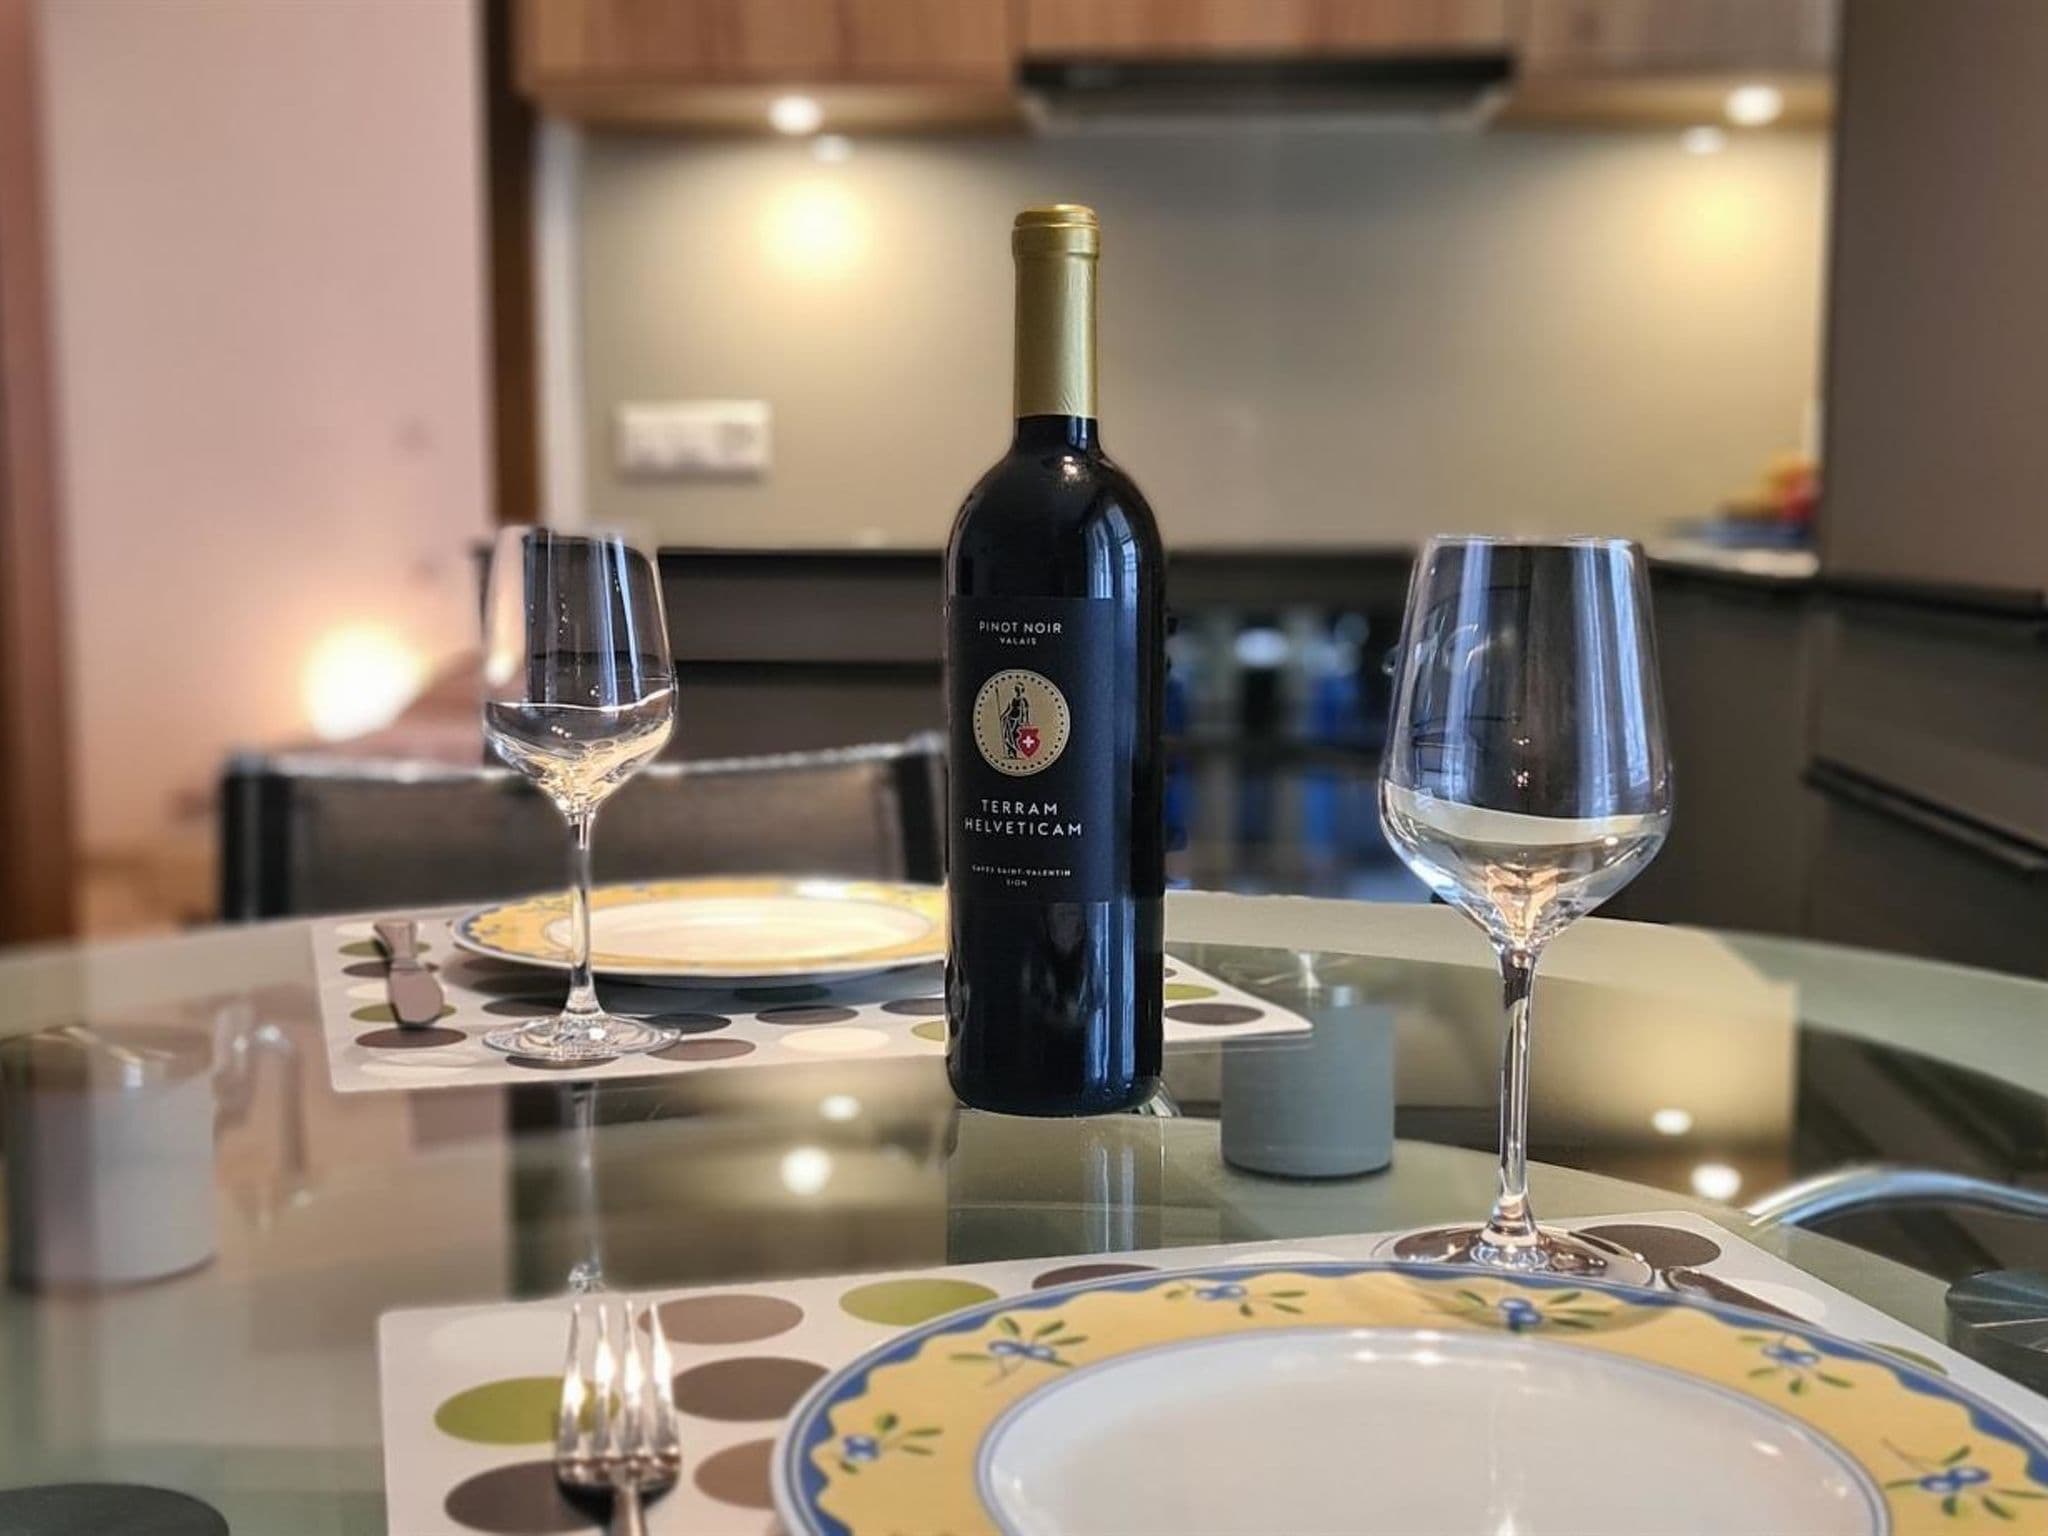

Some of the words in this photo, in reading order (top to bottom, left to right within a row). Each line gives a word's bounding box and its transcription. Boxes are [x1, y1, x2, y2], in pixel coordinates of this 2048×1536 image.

[979, 620, 1018, 632] PINOT
[1023, 622, 1062, 634] NOIR
[999, 637, 1037, 645] VALAIS
[981, 799, 1058, 815] TERRAM
[964, 817, 1081, 836] HELVETICAM
